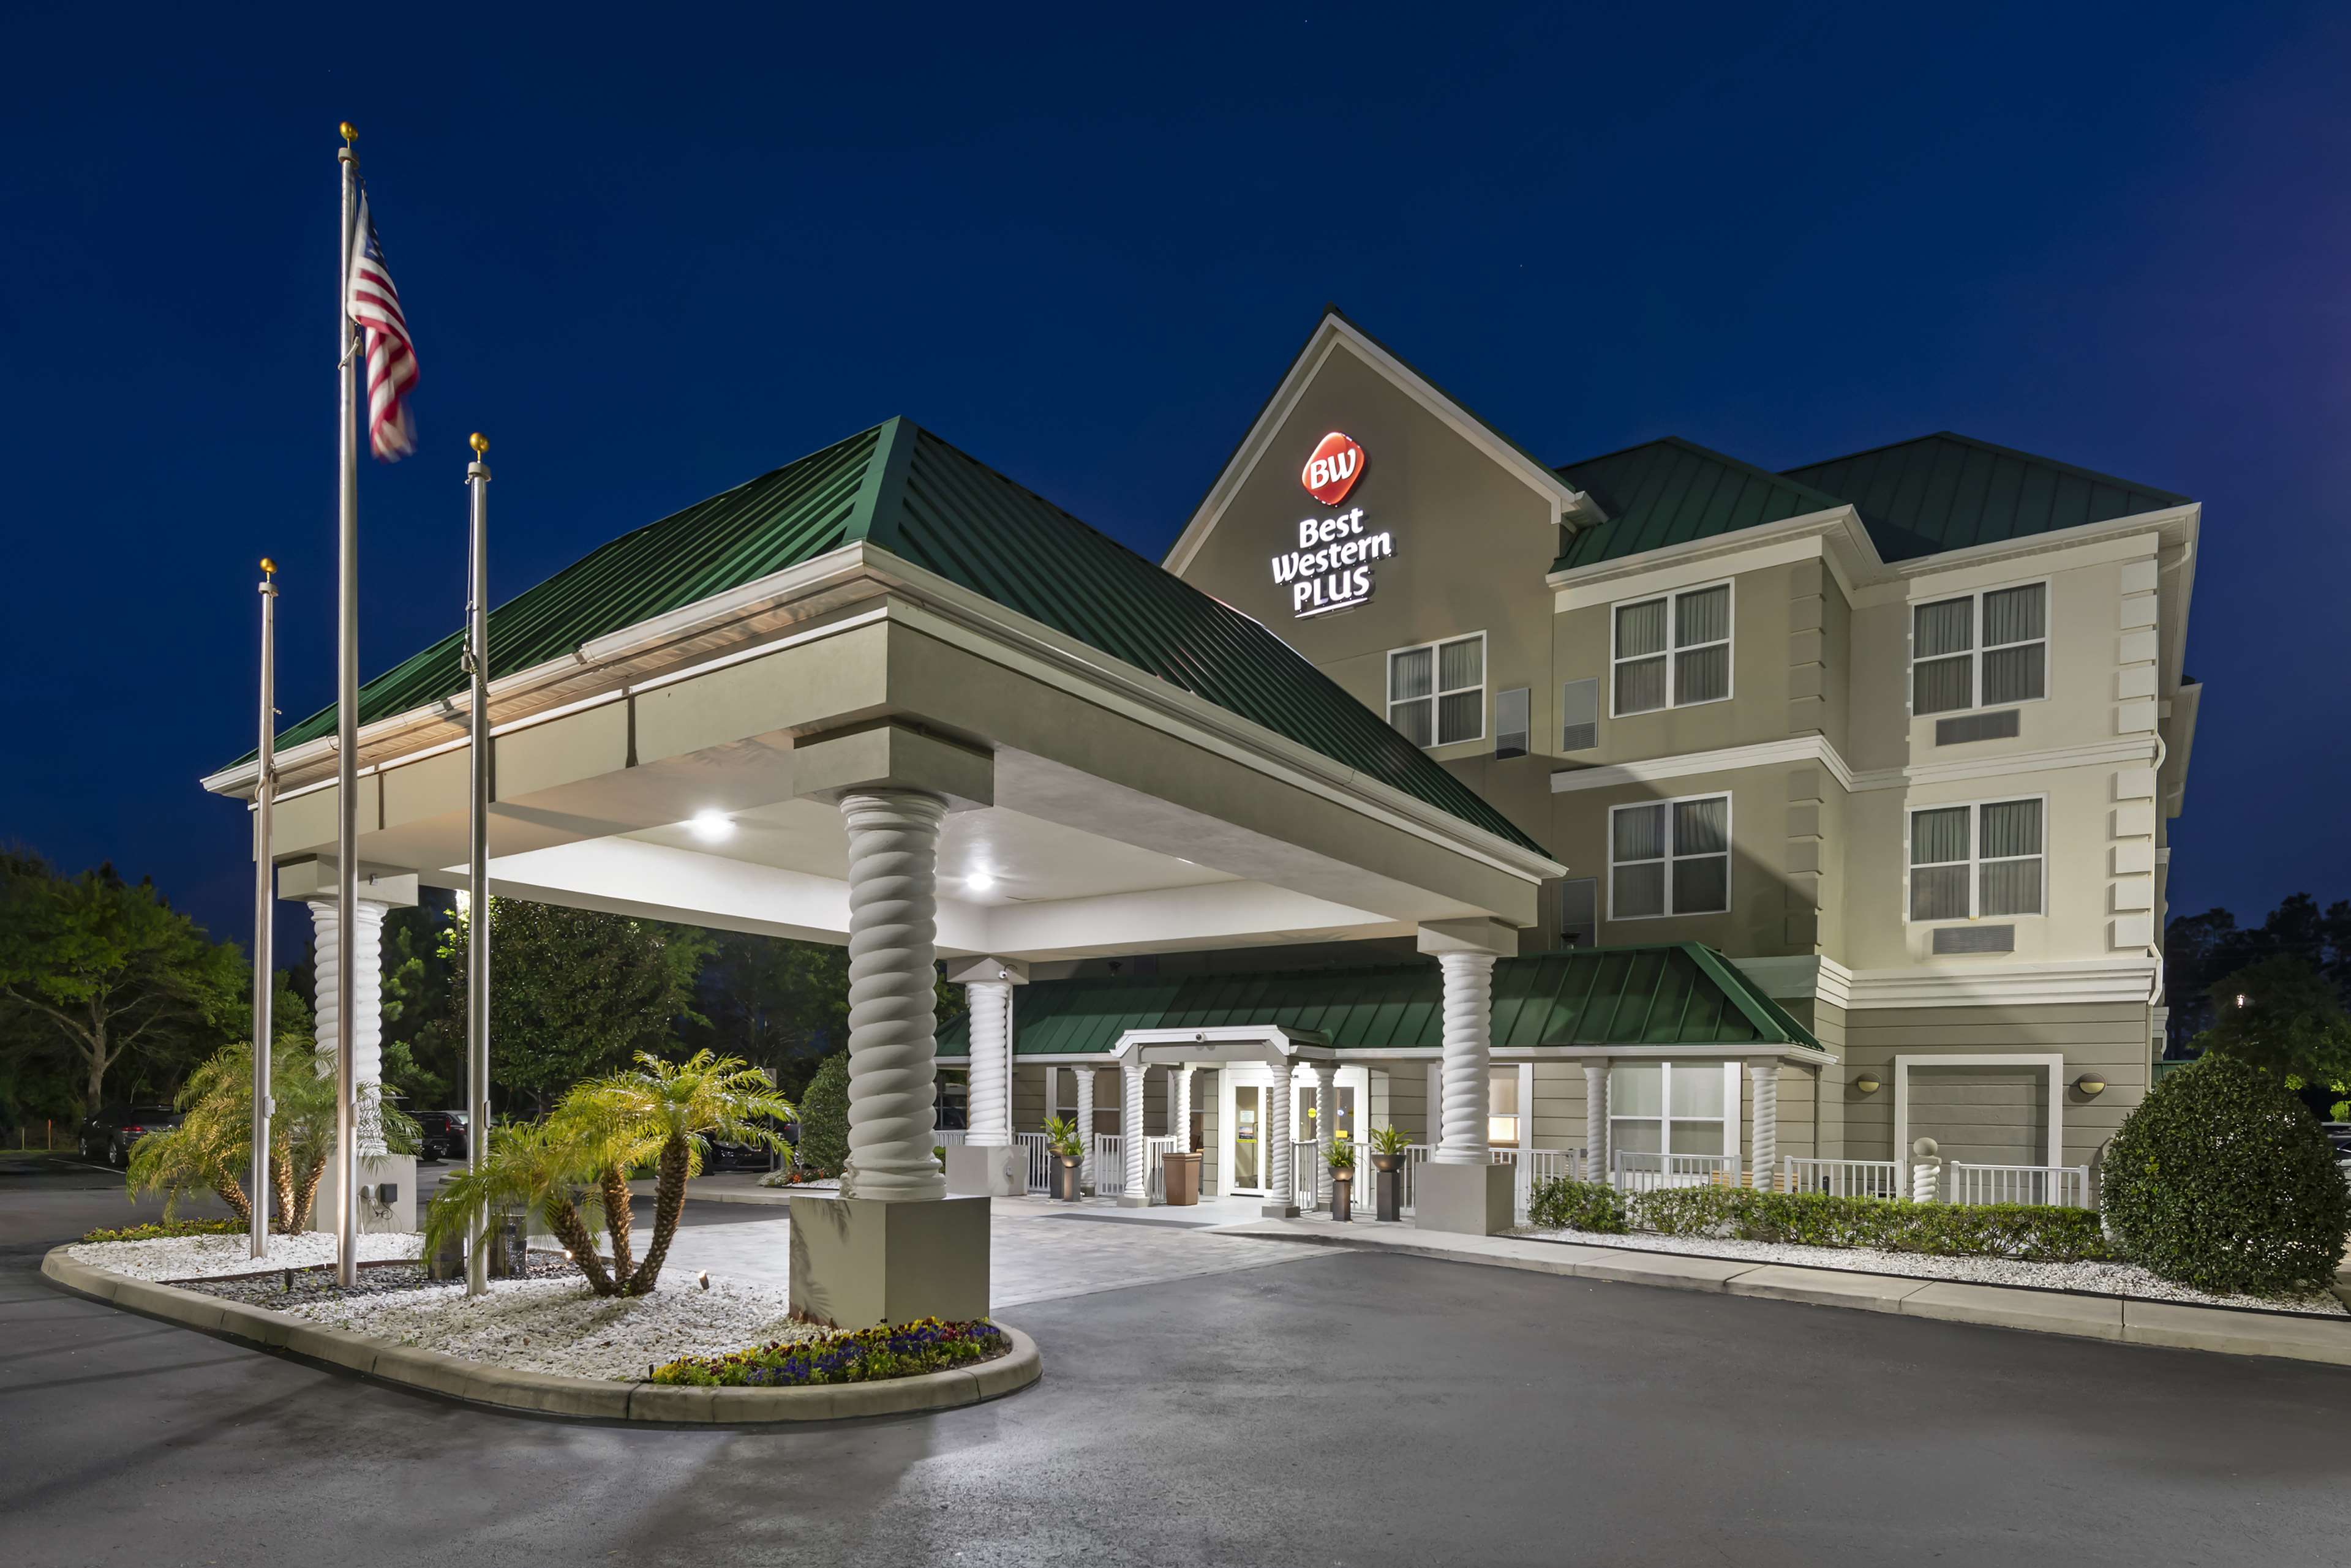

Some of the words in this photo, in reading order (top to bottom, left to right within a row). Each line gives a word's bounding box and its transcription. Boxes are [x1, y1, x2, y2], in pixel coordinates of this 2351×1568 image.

[1310, 449, 1356, 489] BW
[1300, 508, 1363, 548] Best
[1271, 532, 1391, 583] Western
[1293, 566, 1369, 611] PLUS
